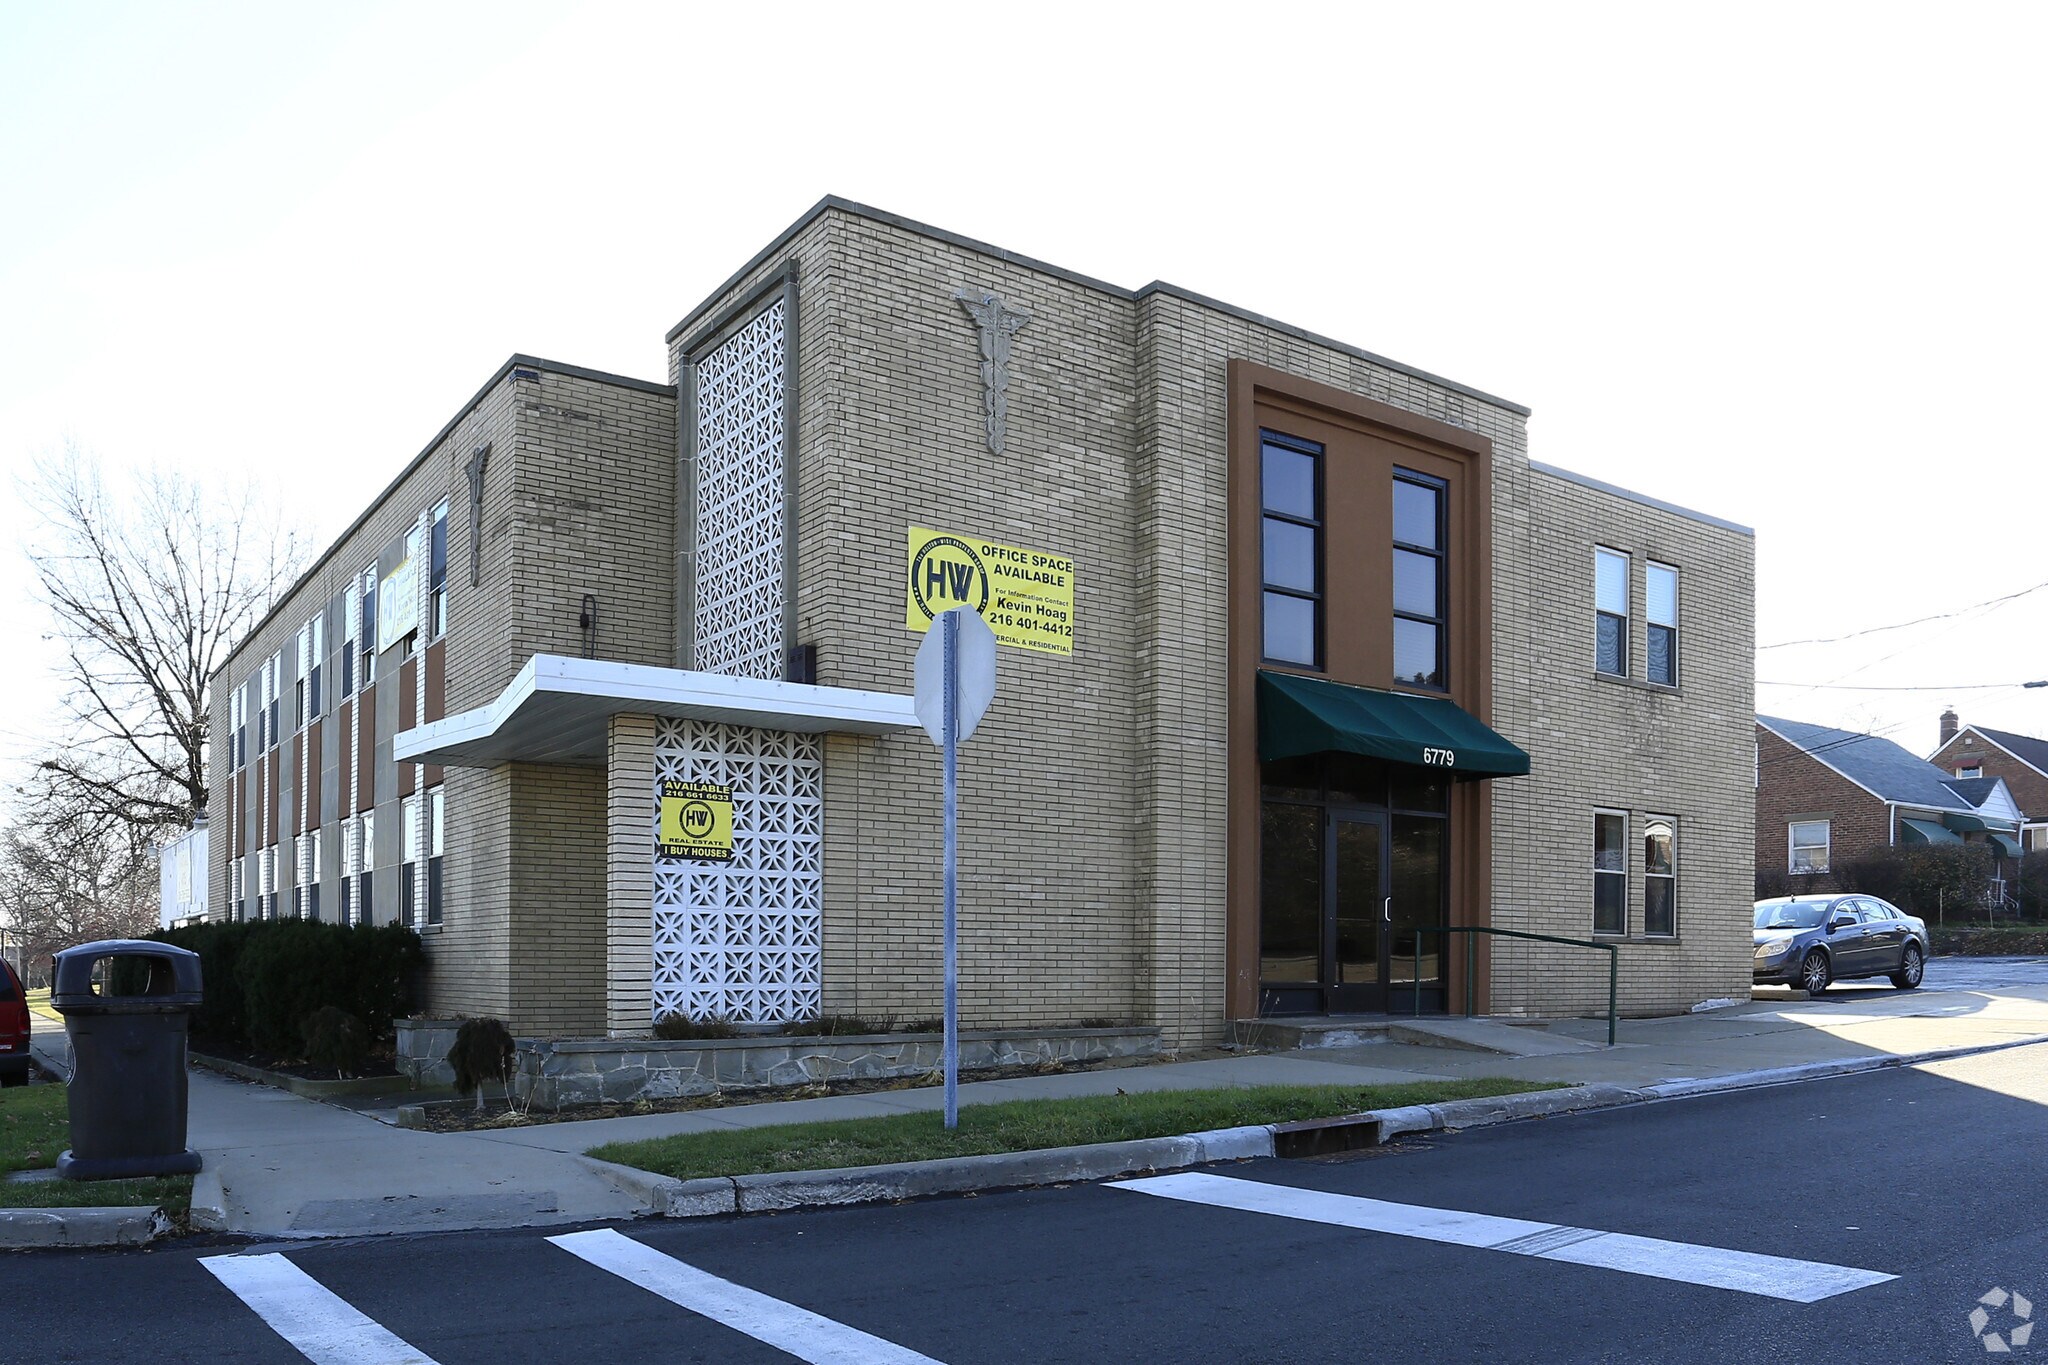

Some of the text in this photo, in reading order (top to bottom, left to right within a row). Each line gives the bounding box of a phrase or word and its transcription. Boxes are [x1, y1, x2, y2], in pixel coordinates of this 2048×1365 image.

[982, 545, 1072, 573] OFFICE SPACE
[926, 557, 975, 602] HW
[994, 564, 1065, 587] AVAILABLE
[1008, 590, 1043, 602] Information
[1045, 597, 1069, 607] Contact
[997, 597, 1032, 613] Kevin
[1036, 604, 1067, 622] Hoag
[989, 612, 1072, 636] 216 401-4412
[996, 635, 1020, 645] ERCIAL
[1029, 640, 1070, 653] RESIDENTIAL
[1423, 747, 1454, 767] 6779
[665, 781, 730, 794] AVAILABLE
[686, 791, 703, 799] 661
[706, 793, 729, 801] 6633
[686, 809, 708, 827] HW
[664, 846, 727, 857] I BUY HOUSES
